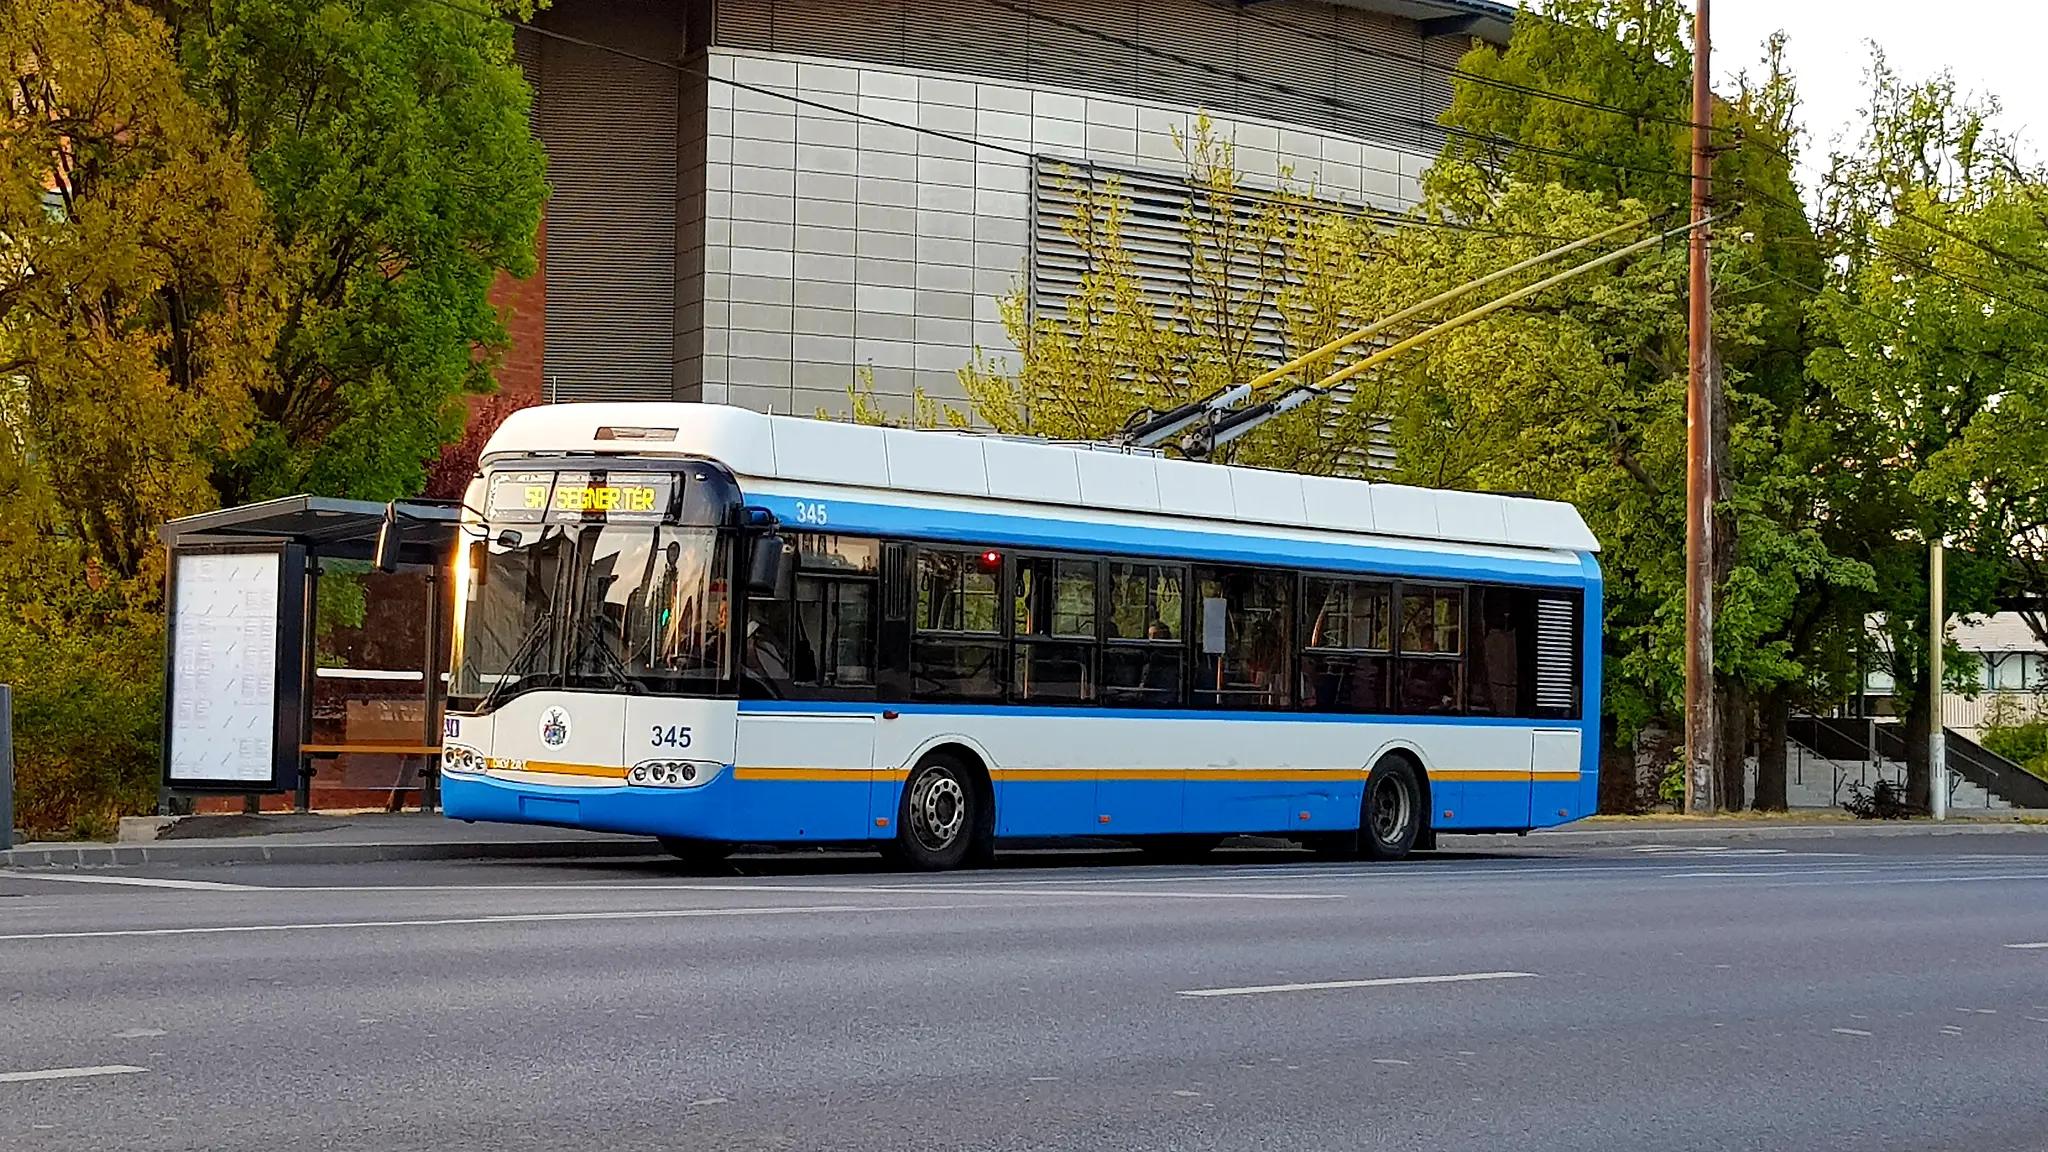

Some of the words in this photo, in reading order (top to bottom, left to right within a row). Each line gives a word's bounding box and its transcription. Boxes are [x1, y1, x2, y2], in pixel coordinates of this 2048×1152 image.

[556, 486, 620, 510] SEGNER
[622, 485, 655, 510] TÉR
[796, 501, 827, 525] 345
[651, 725, 692, 748] 345
